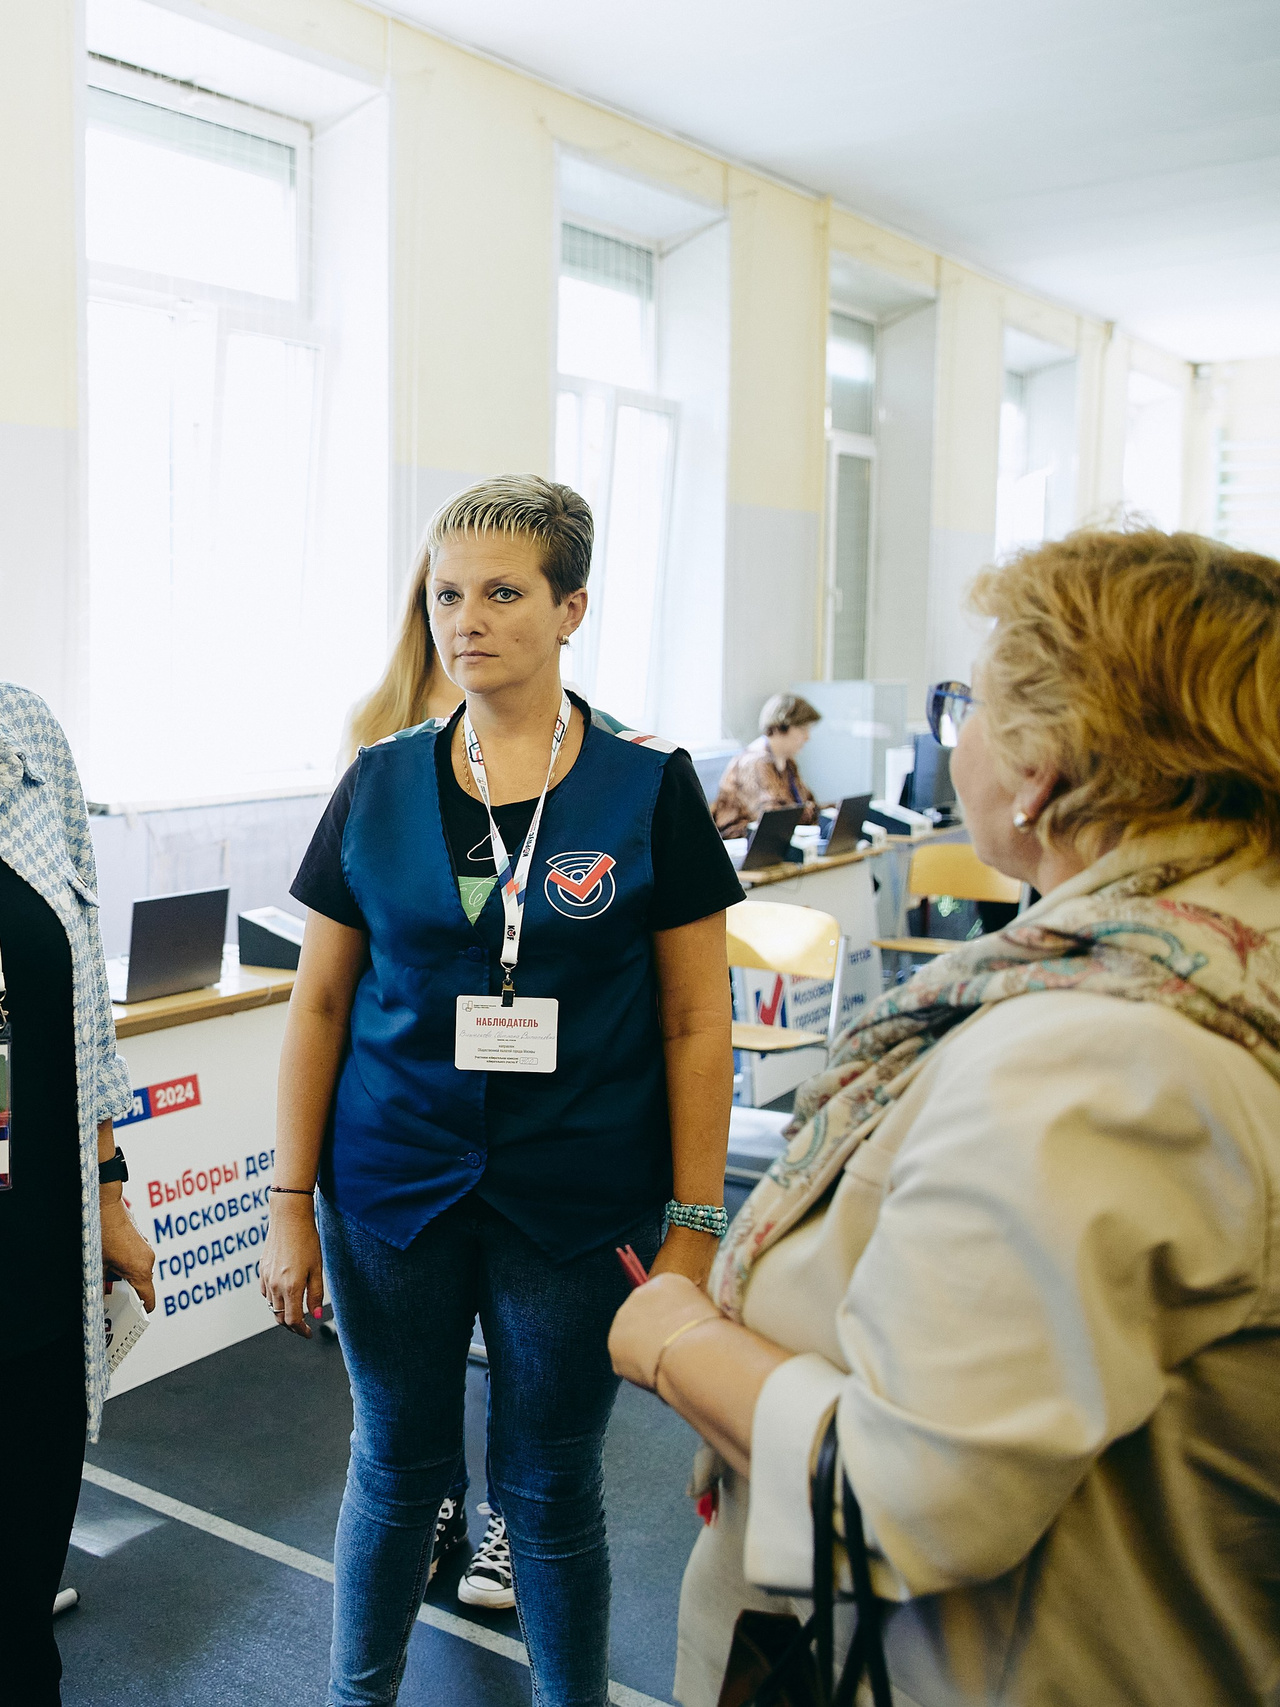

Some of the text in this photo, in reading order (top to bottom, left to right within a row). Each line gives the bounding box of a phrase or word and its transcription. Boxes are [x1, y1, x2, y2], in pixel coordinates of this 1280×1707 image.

[476, 1017, 539, 1028] НАБЛЮДАТЕЛЬ
[155, 1081, 195, 1110] 2024
[147, 1161, 239, 1208] Выборы
